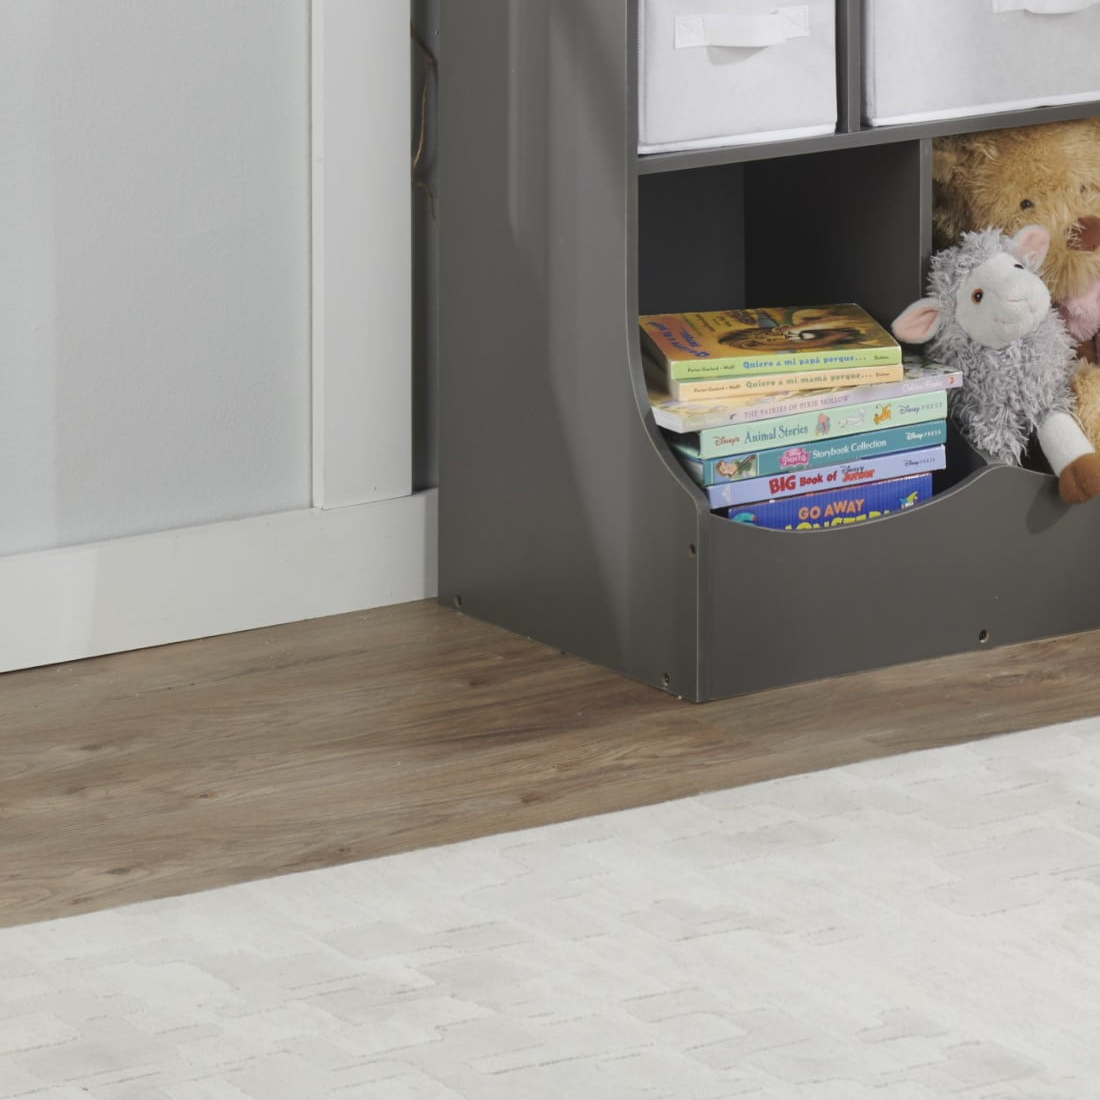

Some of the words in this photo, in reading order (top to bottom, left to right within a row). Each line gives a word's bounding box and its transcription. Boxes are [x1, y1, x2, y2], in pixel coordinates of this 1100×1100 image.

[743, 361, 773, 369] Quiero
[746, 380, 775, 388] Quiero
[743, 411, 758, 419] THE
[760, 405, 788, 416] FAIRIES
[800, 399, 819, 409] PIXIE
[744, 428, 776, 444] Animal
[779, 424, 808, 438] Stories
[812, 446, 849, 458] Storybook
[851, 440, 887, 452] Collection
[769, 475, 796, 494] BIG
[799, 473, 823, 487] Book
[826, 470, 838, 482] of
[799, 507, 820, 520] GO
[824, 499, 865, 517] AWAY
